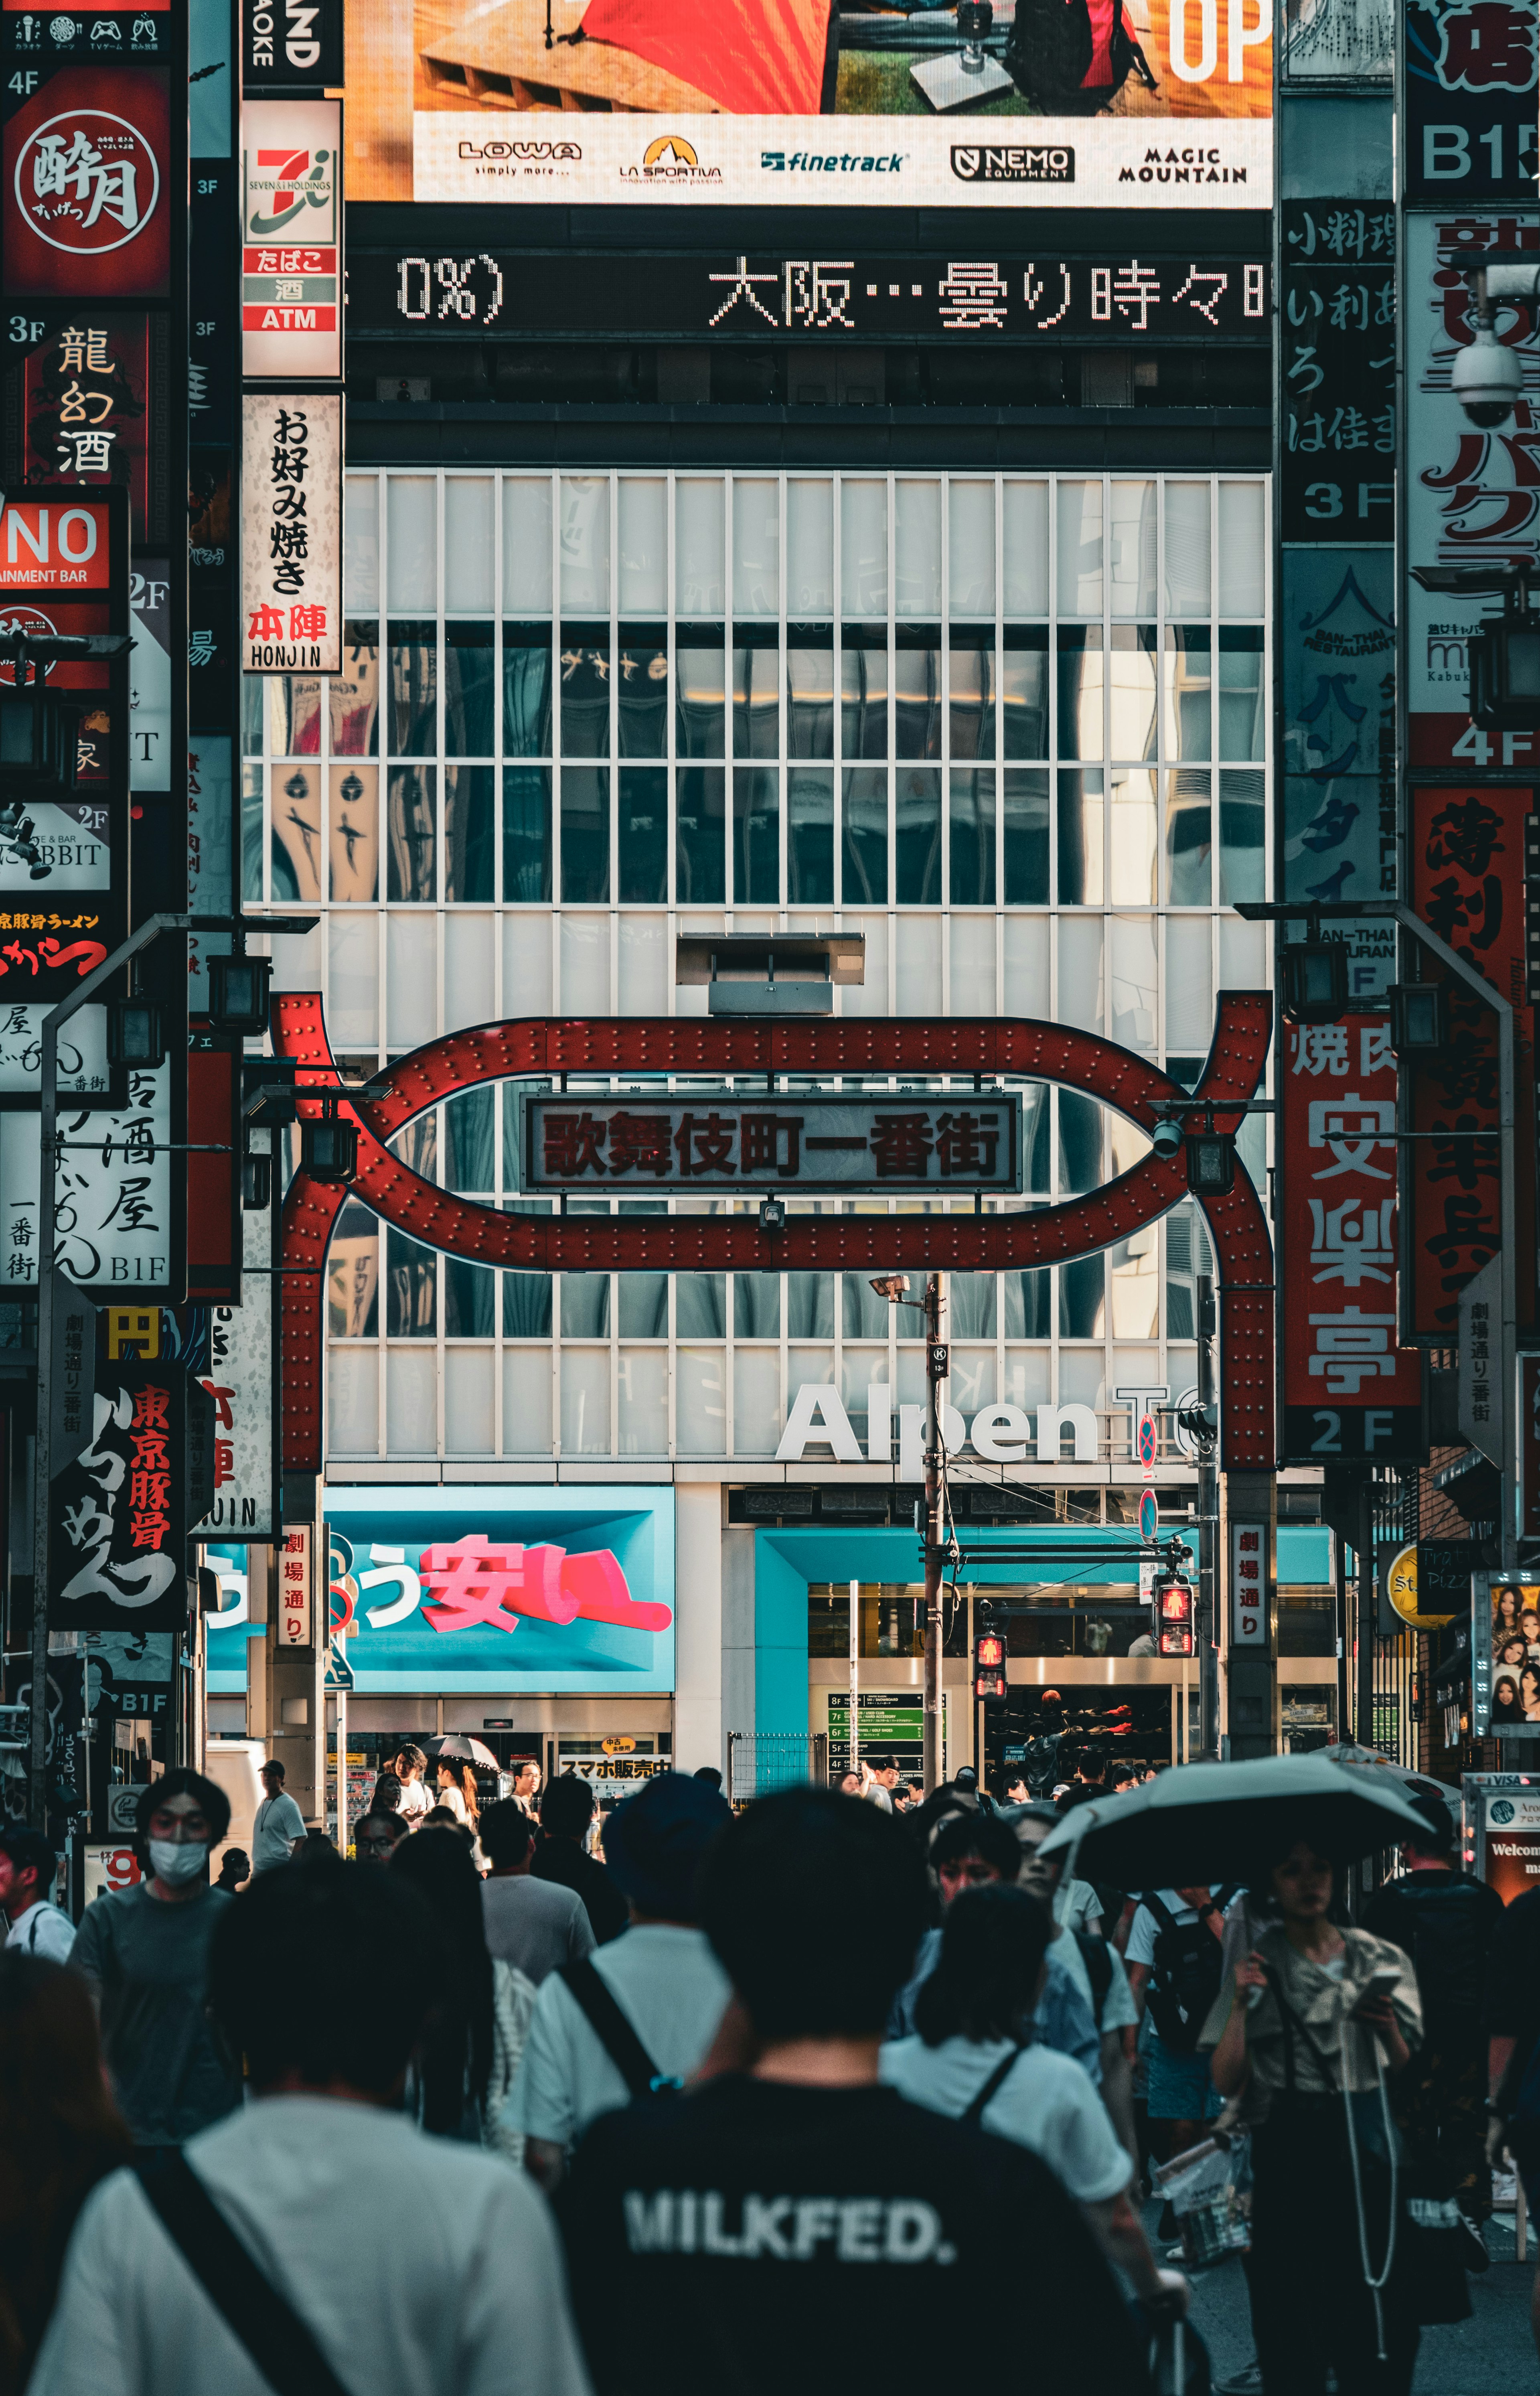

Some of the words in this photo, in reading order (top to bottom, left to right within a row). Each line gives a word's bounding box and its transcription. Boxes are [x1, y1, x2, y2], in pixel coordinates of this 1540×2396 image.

[8, 71, 38, 94] 4F
[459, 142, 582, 159] LOWA
[985, 150, 1068, 168] NEMO
[1145, 148, 1220, 163] MAGIC
[476, 166, 516, 176] simply
[643, 167, 721, 177] SPORTIVA
[985, 170, 1068, 179] EQUIPMENT
[1119, 168, 1247, 183] MOUNTAIN
[197, 181, 217, 194] 3F
[287, 181, 330, 191] HOLDINGS
[32, 201, 83, 220] すいげつ
[257, 251, 322, 272] たばこ
[275, 279, 304, 300] 酒
[9, 316, 45, 342] 3F
[196, 322, 216, 335] 3F
[261, 310, 316, 329] ATM
[57, 325, 116, 483] 龍幻酒
[270, 409, 309, 595] お好み焼き
[1304, 483, 1395, 518] 3F
[60, 570, 87, 582] BAR
[248, 604, 327, 643] 本陣
[251, 645, 321, 667] HONJIN
[1452, 726, 1534, 765] 4F
[79, 806, 108, 829] 2F
[0, 1006, 32, 1035] 屋
[1290, 1023, 1396, 1077] 焼肉
[543, 1111, 1000, 1177] 歌舞伎町一番街
[6, 1201, 36, 1280] 一番街
[1308, 1093, 1396, 1394] 安楽亭
[110, 1257, 165, 1280] B1F
[775, 1384, 1097, 1482] Alpen
[1310, 1410, 1394, 1452] 2F
[129, 1384, 171, 1550] 東京豚骨
[284, 1534, 304, 1636] 劇場通り
[1238, 1532, 1260, 1635] 劇場通り
[122, 1693, 166, 1712] B1F
[561, 1759, 671, 1779] スマホ販売中
[1493, 1775, 1521, 1785] VISA
